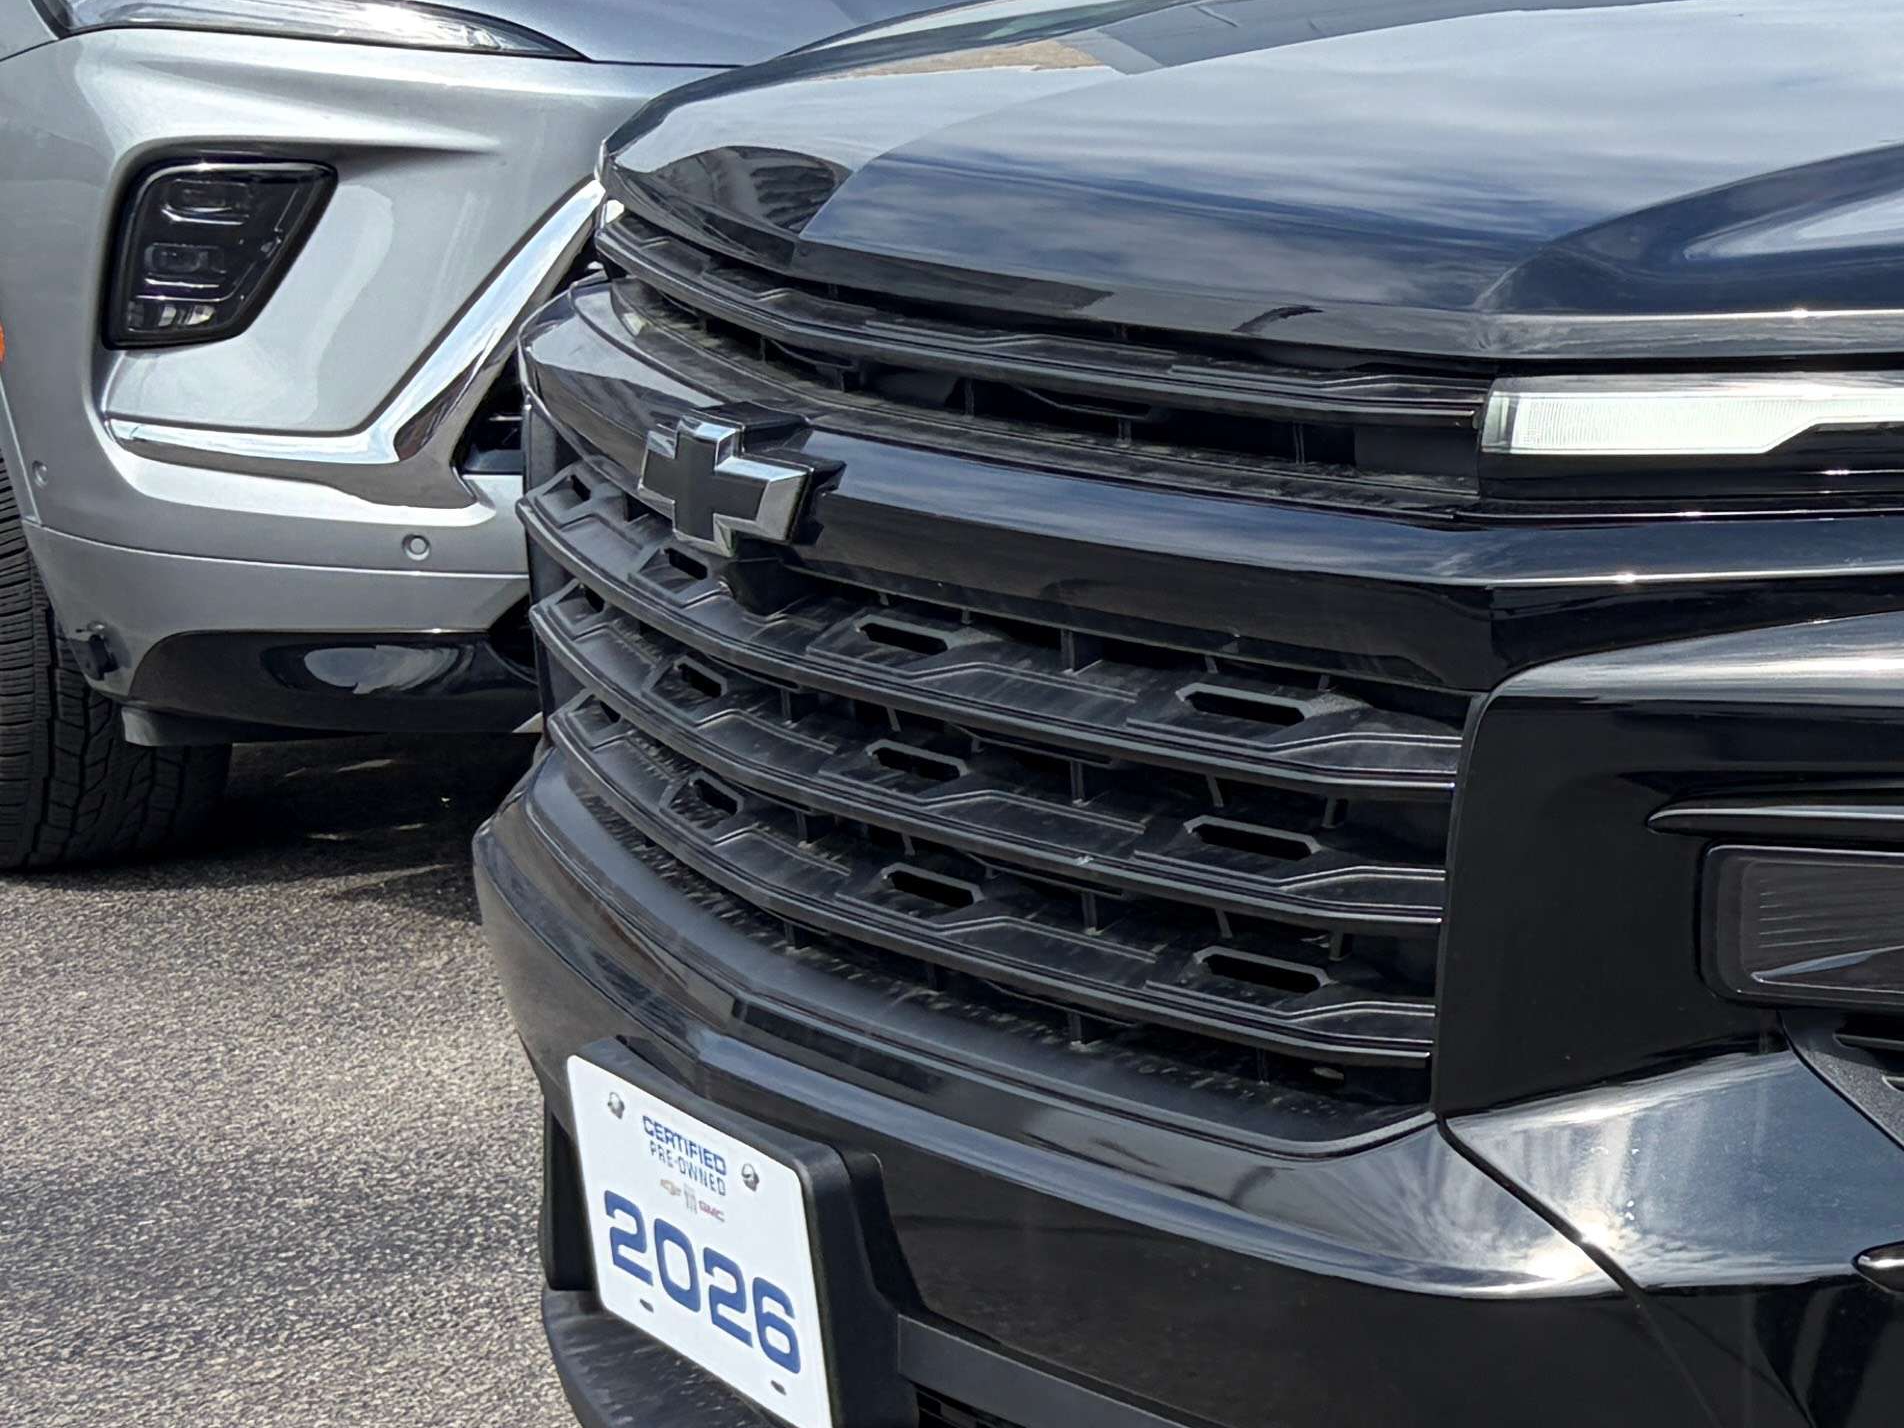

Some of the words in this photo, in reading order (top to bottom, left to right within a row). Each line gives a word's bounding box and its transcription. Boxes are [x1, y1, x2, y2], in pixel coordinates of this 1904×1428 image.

[641, 1114, 728, 1177] CERTIFIED
[648, 1139, 727, 1197] PRE-OWNED
[698, 1200, 726, 1223] GMC
[603, 1188, 802, 1376] 2026
